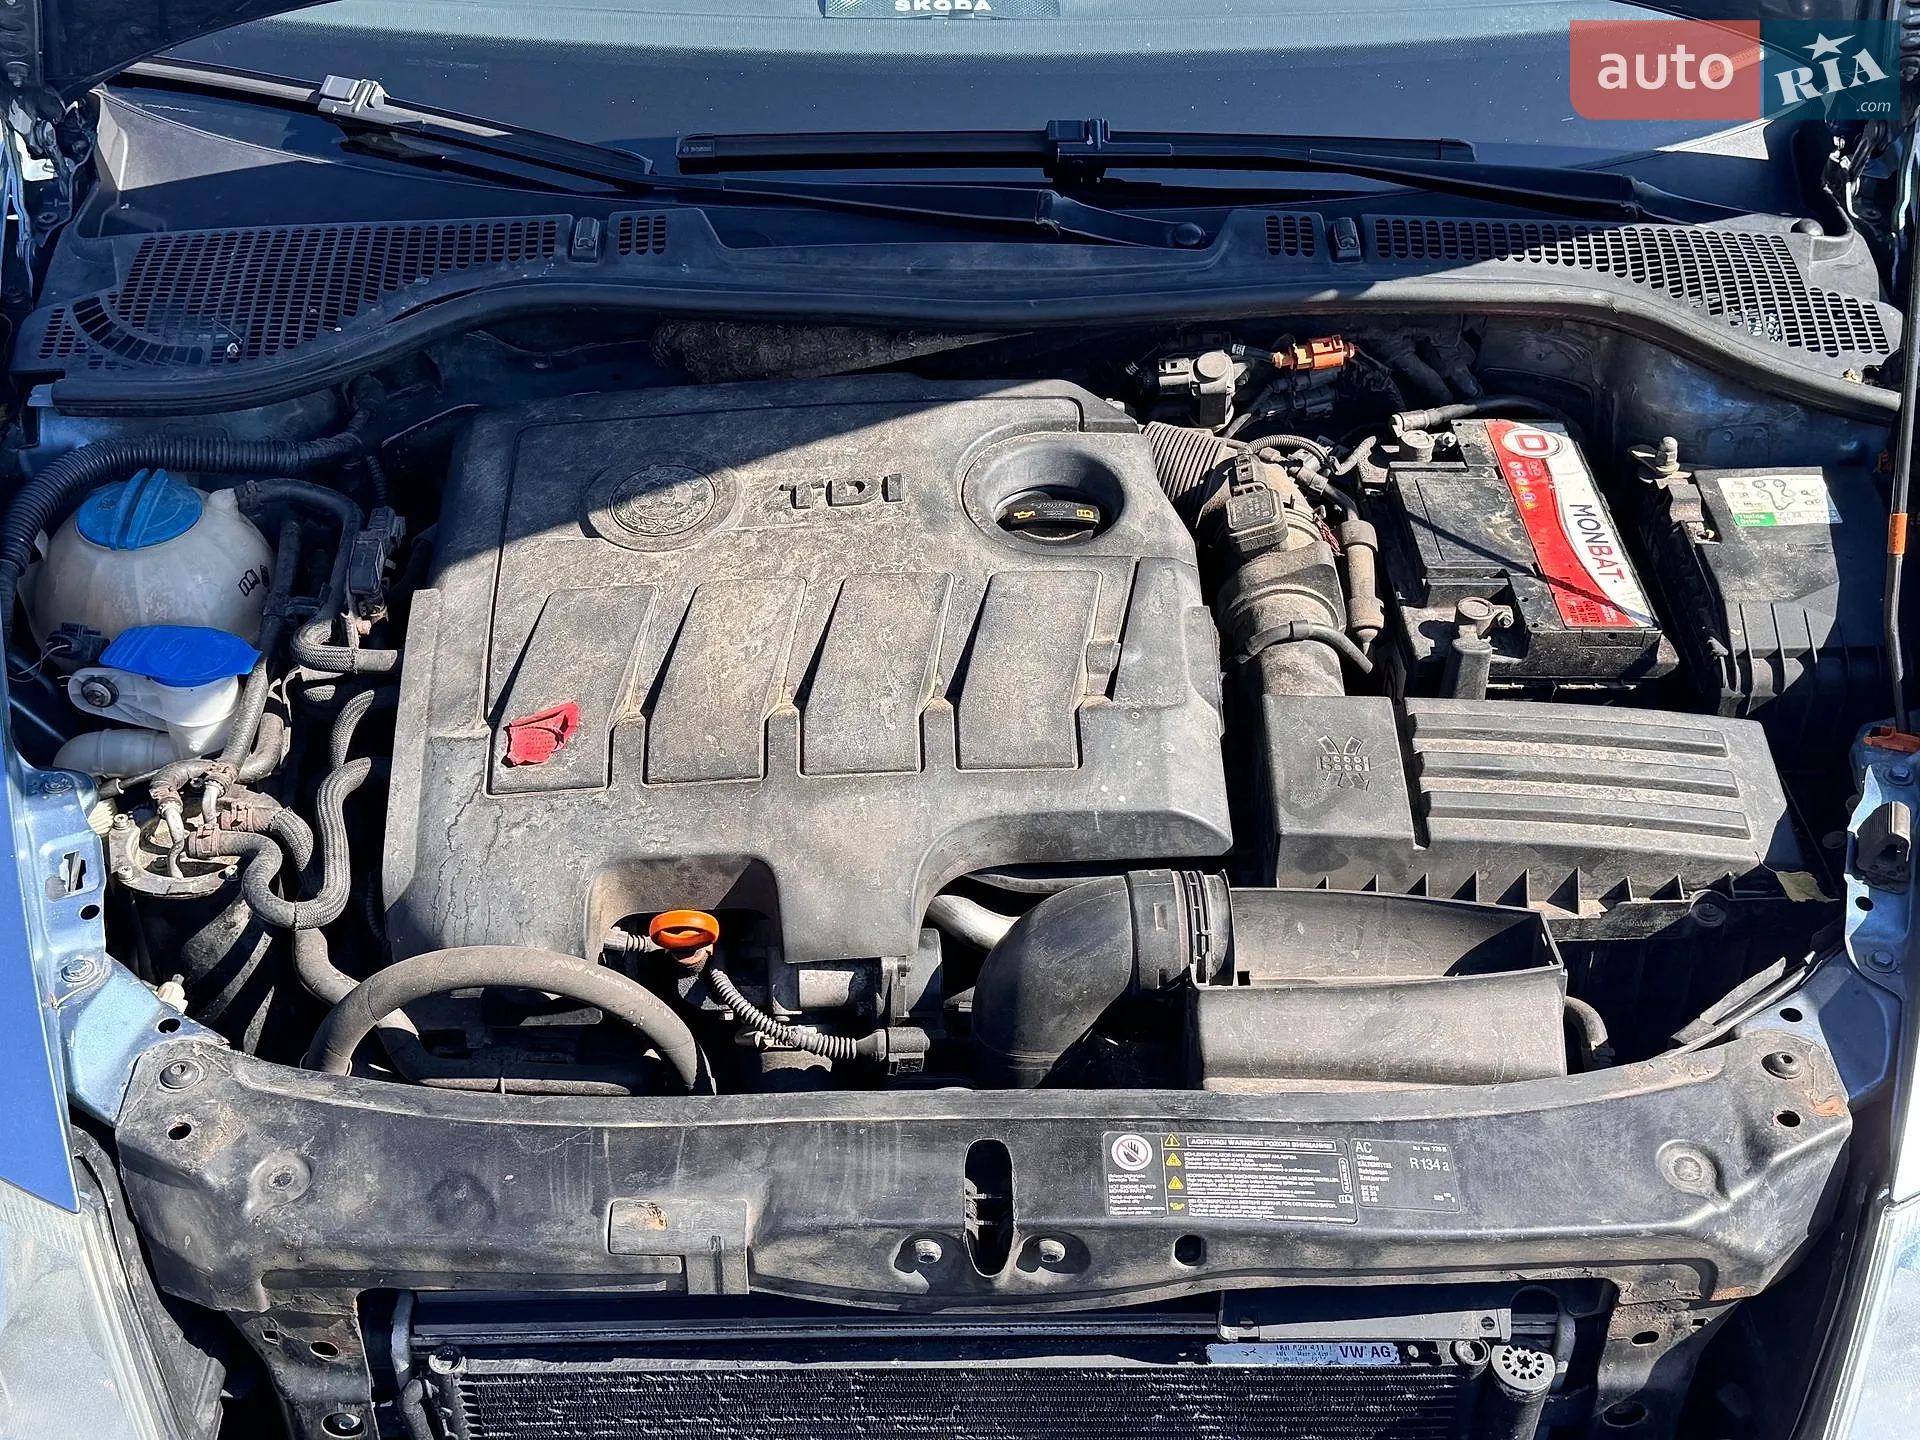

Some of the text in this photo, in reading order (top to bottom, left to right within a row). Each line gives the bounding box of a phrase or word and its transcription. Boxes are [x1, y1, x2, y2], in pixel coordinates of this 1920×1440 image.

[778, 474, 904, 509] TDI
[1569, 504, 1625, 580] MONBAT
[1355, 1141, 1372, 1153] AC
[1339, 1345, 1364, 1358] VW
[1371, 1345, 1391, 1358] AG
